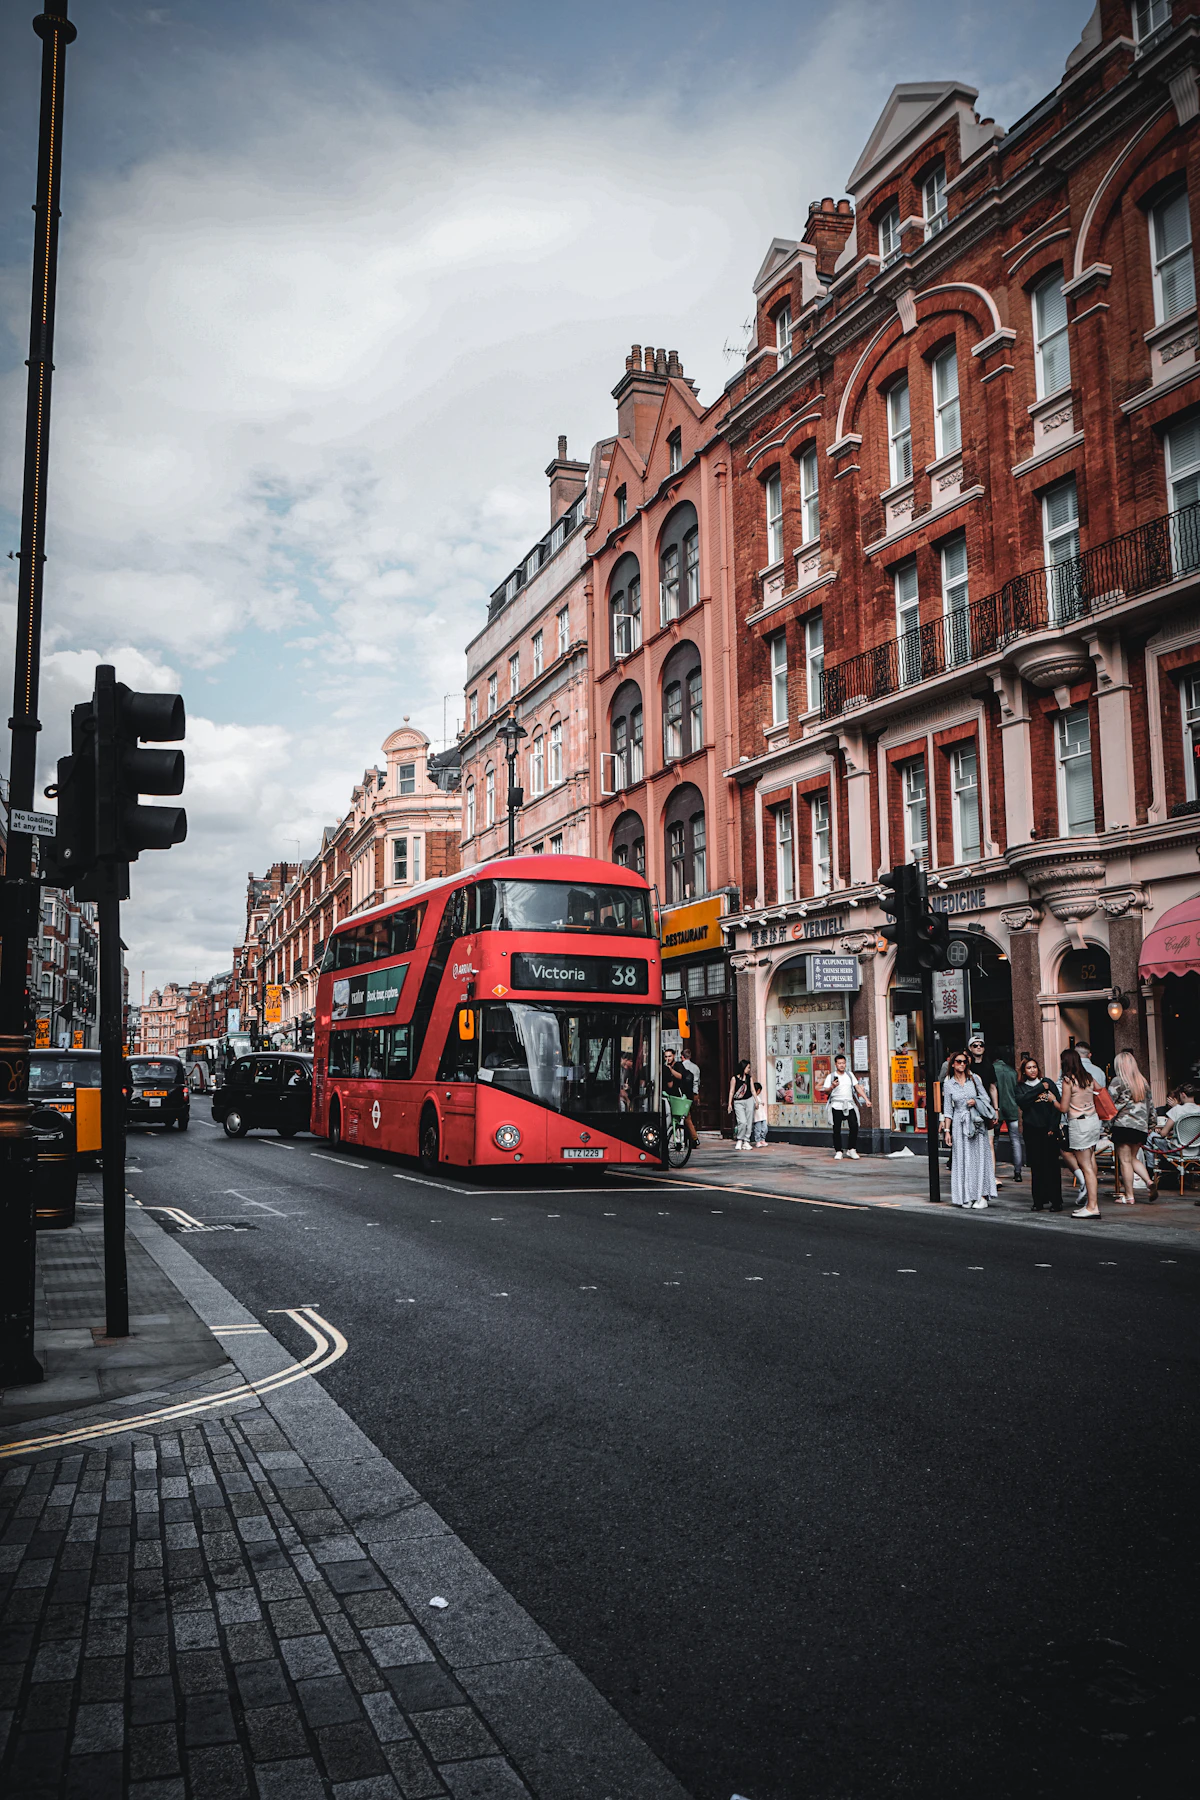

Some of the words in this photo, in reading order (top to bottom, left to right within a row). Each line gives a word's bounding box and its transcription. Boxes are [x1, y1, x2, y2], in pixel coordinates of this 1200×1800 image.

[15, 812, 26, 820] No
[28, 815, 53, 826] loading
[38, 825, 54, 835] time
[932, 888, 986, 913] MEDICINE
[665, 925, 709, 948] RESTAURANT
[822, 958, 854, 966] ACUPUNCTURE
[531, 964, 586, 980] Victoria
[611, 965, 636, 986] 38
[1081, 964, 1097, 980] 52
[567, 1149, 582, 1157] LTZ
[583, 1149, 599, 1157] 1229
